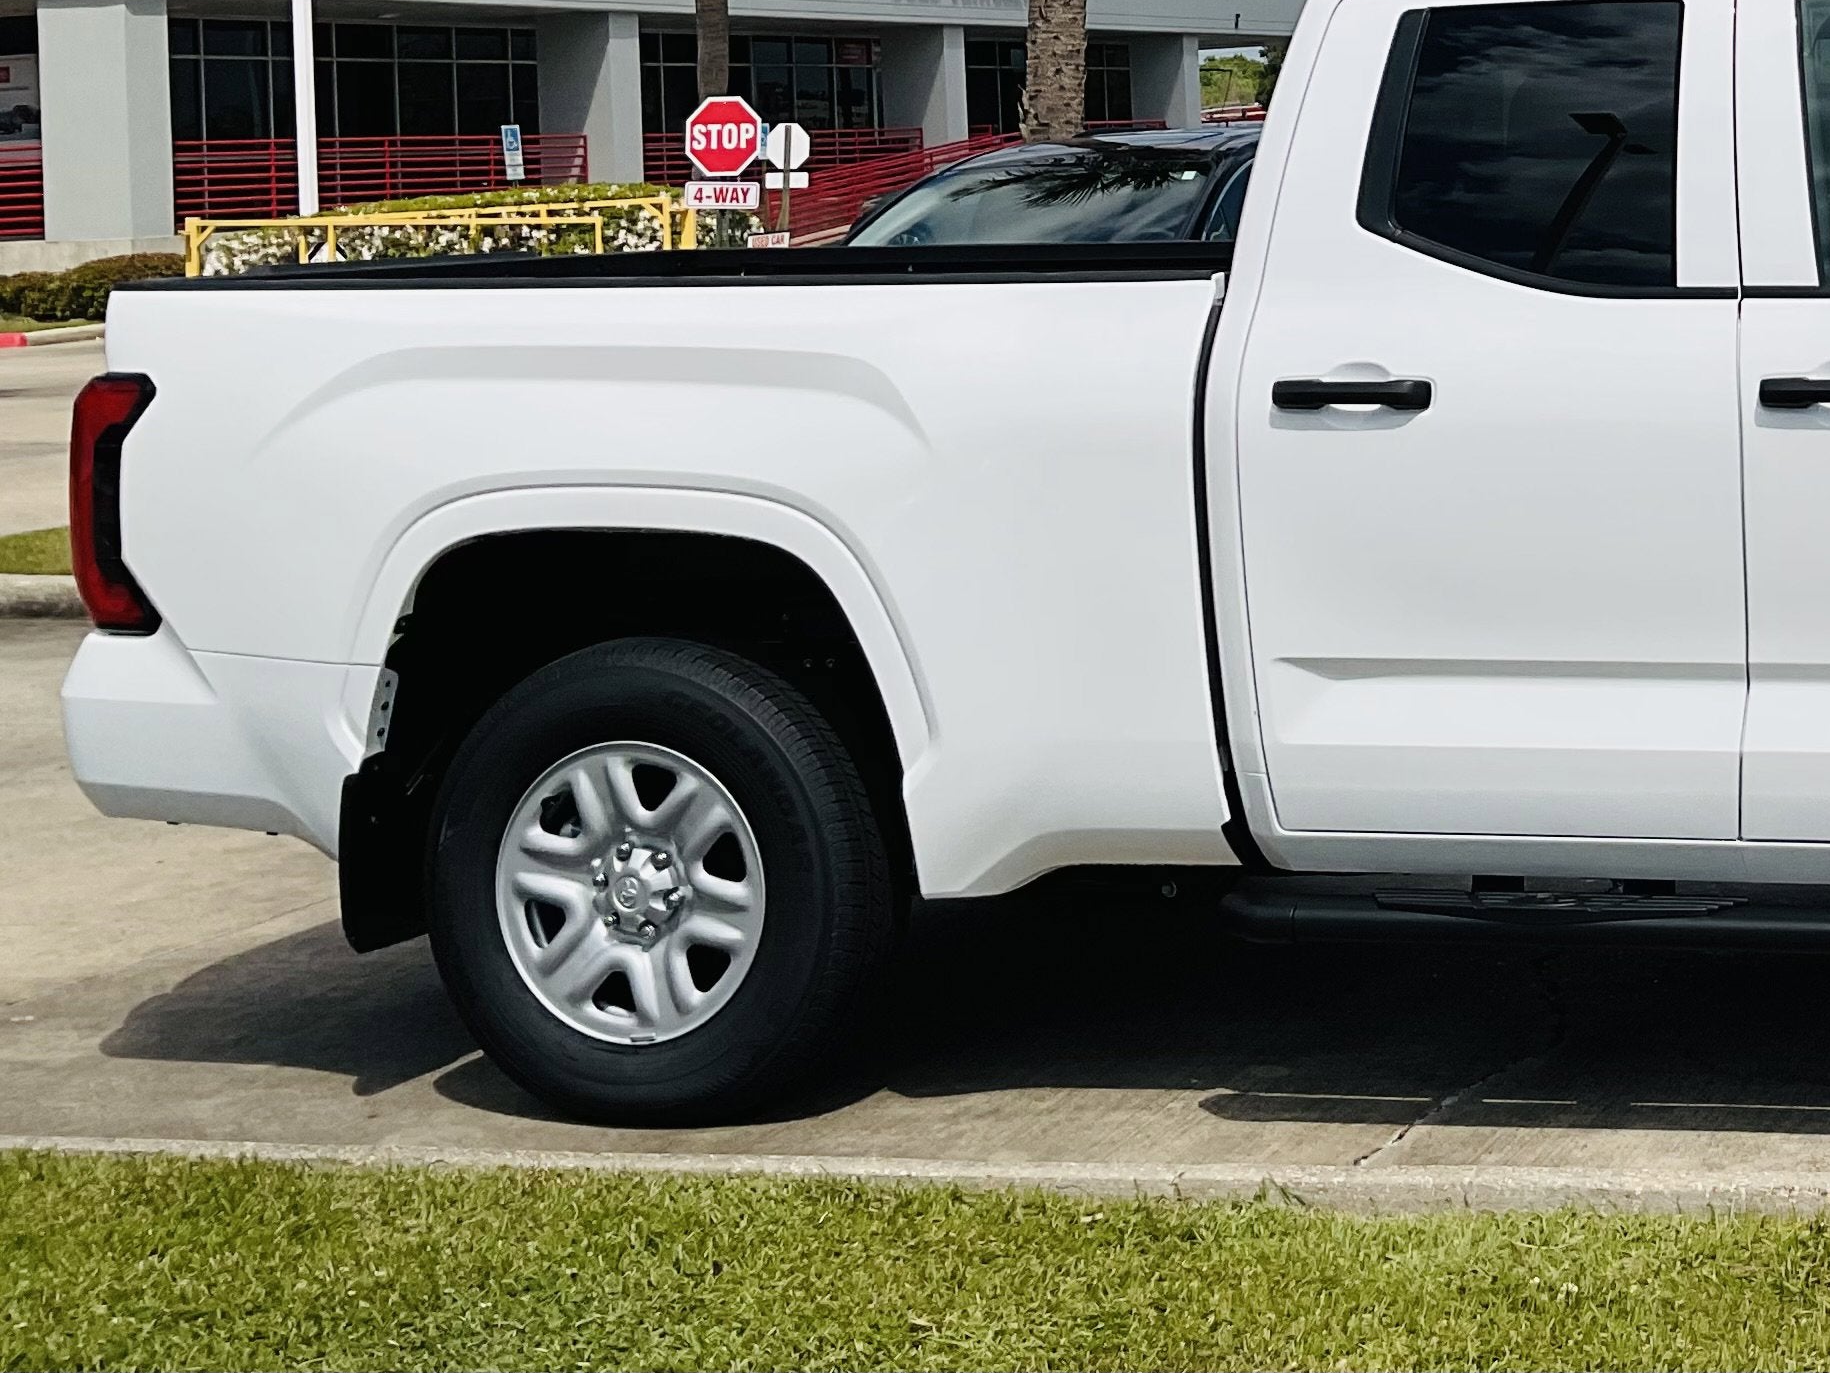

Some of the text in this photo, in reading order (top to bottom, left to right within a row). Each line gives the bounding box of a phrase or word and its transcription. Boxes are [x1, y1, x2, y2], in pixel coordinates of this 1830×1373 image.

[692, 123, 755, 150] STOP
[693, 187, 750, 203] 4-WAY
[772, 235, 785, 245] CAR
